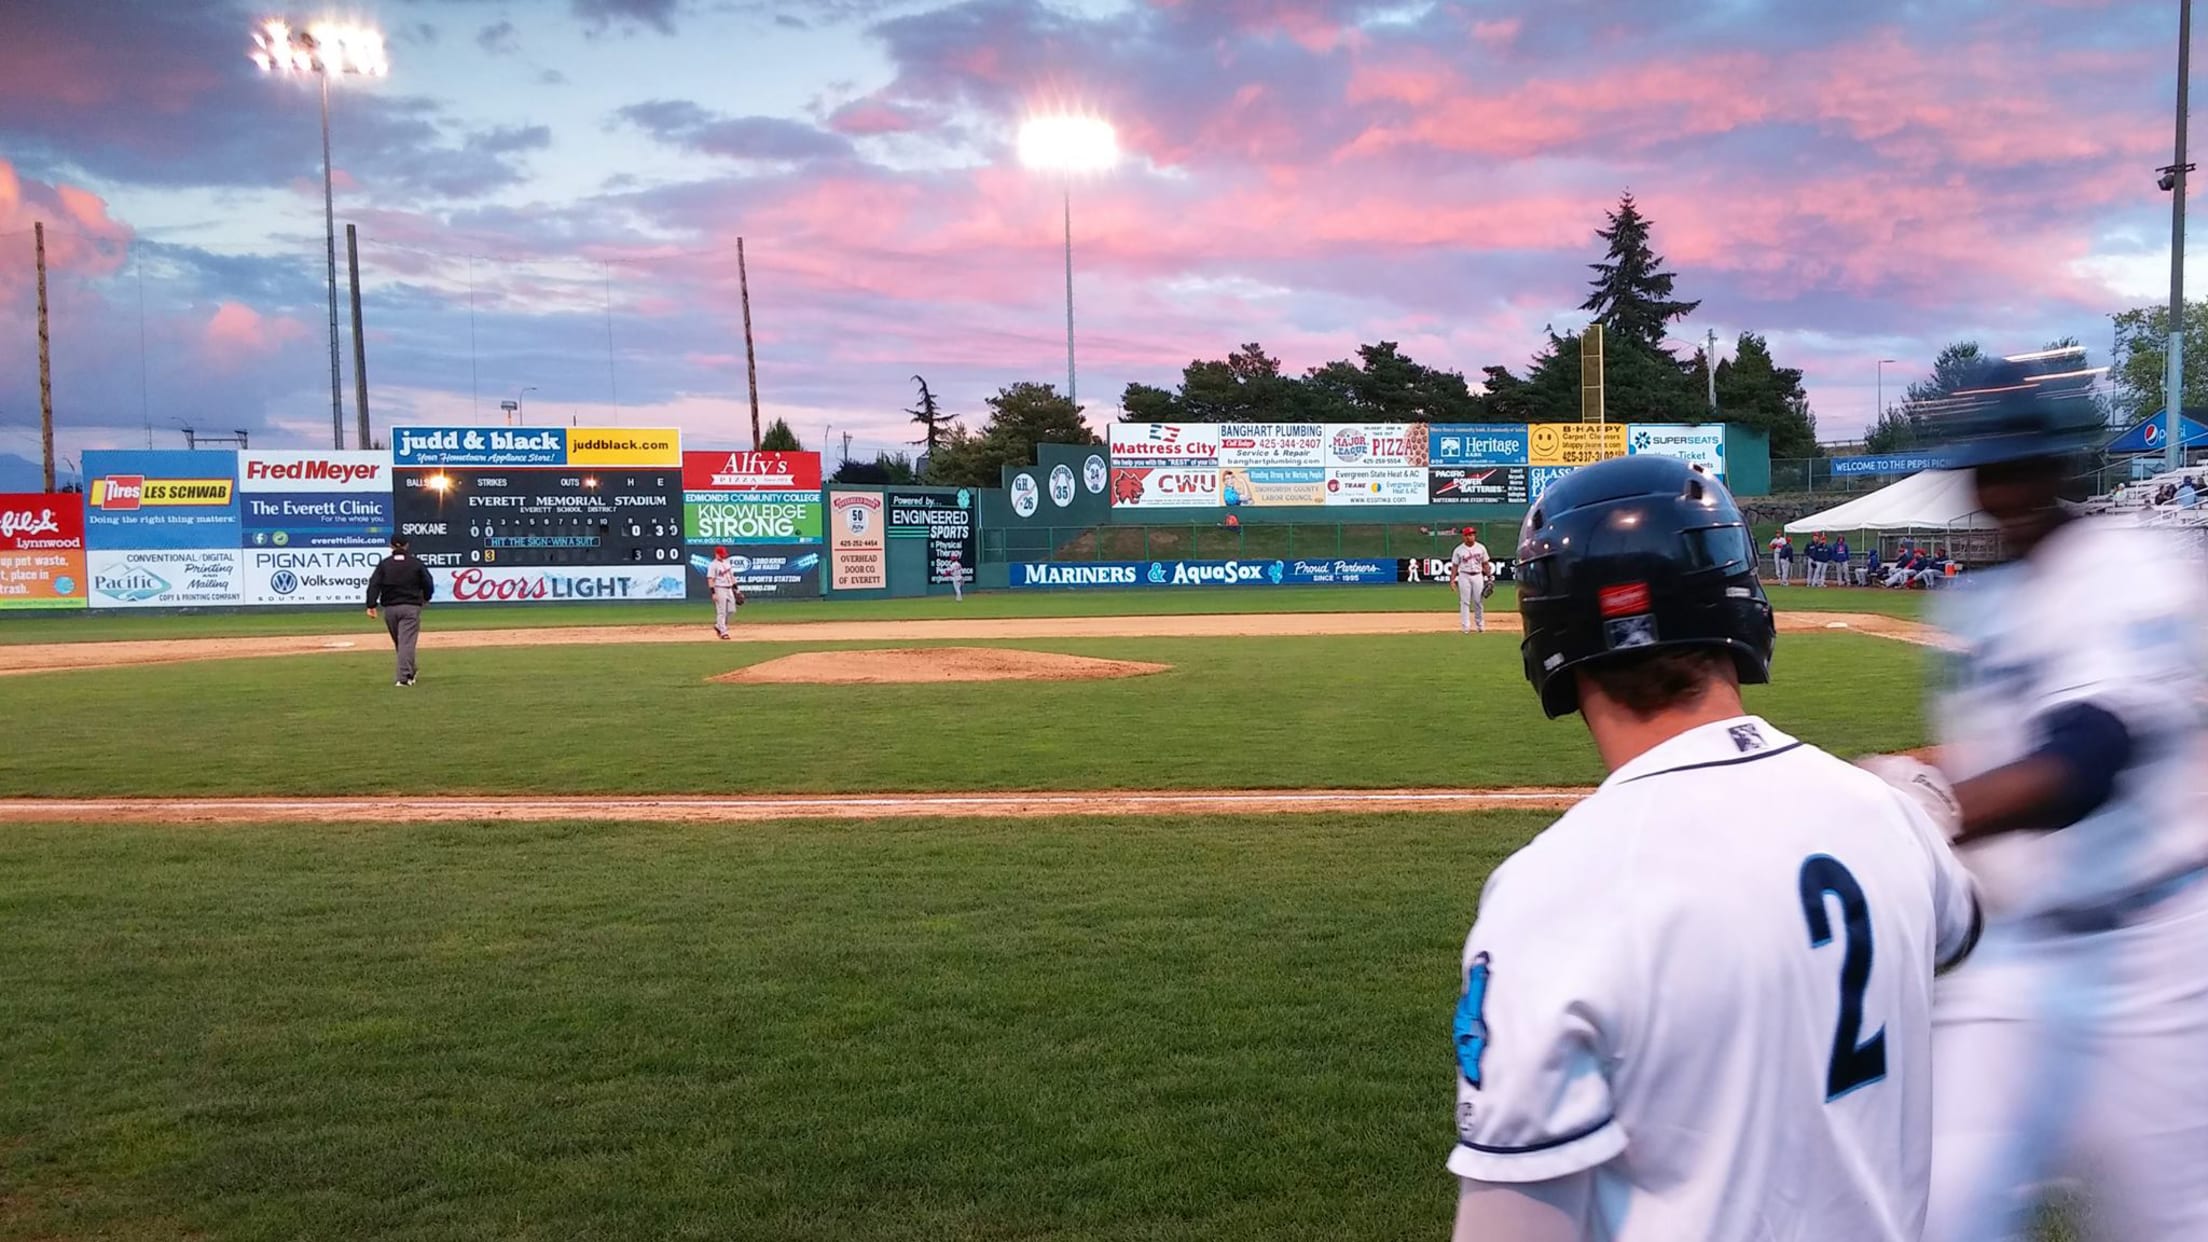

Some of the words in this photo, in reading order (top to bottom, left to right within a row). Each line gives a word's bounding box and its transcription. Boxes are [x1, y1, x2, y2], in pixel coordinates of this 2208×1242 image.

[1221, 425, 1273, 437] BANGHART
[1276, 425, 1322, 437] PLUMBING
[400, 431, 459, 455] judd
[464, 431, 485, 450] &
[491, 431, 561, 450] black
[573, 439, 669, 453] juddblack.com
[1260, 440, 1321, 448] 425-344-2407
[1333, 437, 1366, 446] MAJOR
[1372, 438, 1413, 456] PIZZA
[1465, 437, 1519, 455] Heritage
[1112, 442, 1181, 454] Mattress
[1186, 442, 1216, 456] City
[1333, 446, 1367, 455] LEAGUE
[1836, 462, 1875, 471] WELCOME
[1877, 461, 1888, 469] TO
[1890, 461, 1904, 469] THE
[1907, 460, 1930, 468] PEPSI
[247, 460, 303, 480] Fred
[305, 460, 380, 484] Meyer
[1335, 471, 1369, 480] Evergreen
[477, 478, 507, 486] STRIKES
[561, 478, 580, 486] OUTS
[627, 478, 635, 486] H
[657, 478, 664, 486] E
[1158, 475, 1216, 492] CWU
[106, 481, 139, 500] Tires
[144, 486, 165, 498] LES
[169, 486, 226, 498] SCHWAB
[1056, 486, 1068, 499] 35
[468, 497, 526, 506] EVERETT
[536, 496, 606, 506] MEMORIAL
[614, 496, 667, 506] STADIUM
[686, 494, 729, 502] EDMONDS
[730, 494, 782, 502] COMMUNITY
[783, 494, 820, 502] COLLEGE
[893, 496, 922, 504] Powered
[250, 501, 279, 515] The
[284, 501, 335, 515] Everett
[340, 500, 382, 515] Clinic
[699, 505, 806, 519] KNOWLEDGE
[122, 515, 137, 523] the
[140, 515, 164, 524] right
[168, 515, 193, 524] thing
[852, 509, 863, 521] 50
[892, 510, 968, 524] ENGINEERED
[402, 523, 447, 535] SPOKANE
[470, 526, 480, 537] 0
[485, 526, 494, 537] 0
[631, 525, 641, 536] 0
[655, 525, 664, 536] 3
[699, 519, 794, 537] STRONG
[930, 526, 969, 538] SPORTS
[16, 538, 80, 549] Lynnwood
[311, 537, 385, 545] everettclinic.com
[257, 553, 382, 568] PIGNATARO
[471, 550, 480, 562] 0
[486, 550, 493, 560] 3
[656, 549, 664, 560] 0
[670, 549, 679, 559] 0
[184, 564, 233, 574] Printing
[1147, 562, 1167, 583] &
[1171, 561, 1262, 584] AquaSox
[1294, 561, 1329, 574] Proud
[1333, 561, 1381, 574] Partners
[95, 576, 155, 589] Pacific
[187, 579, 229, 591] Mailing
[300, 575, 370, 588] Volkswage
[451, 568, 547, 600] Coors
[552, 577, 631, 597] LIGHT
[851, 576, 880, 584] EVERETT
[1799, 853, 1888, 1103] 2
